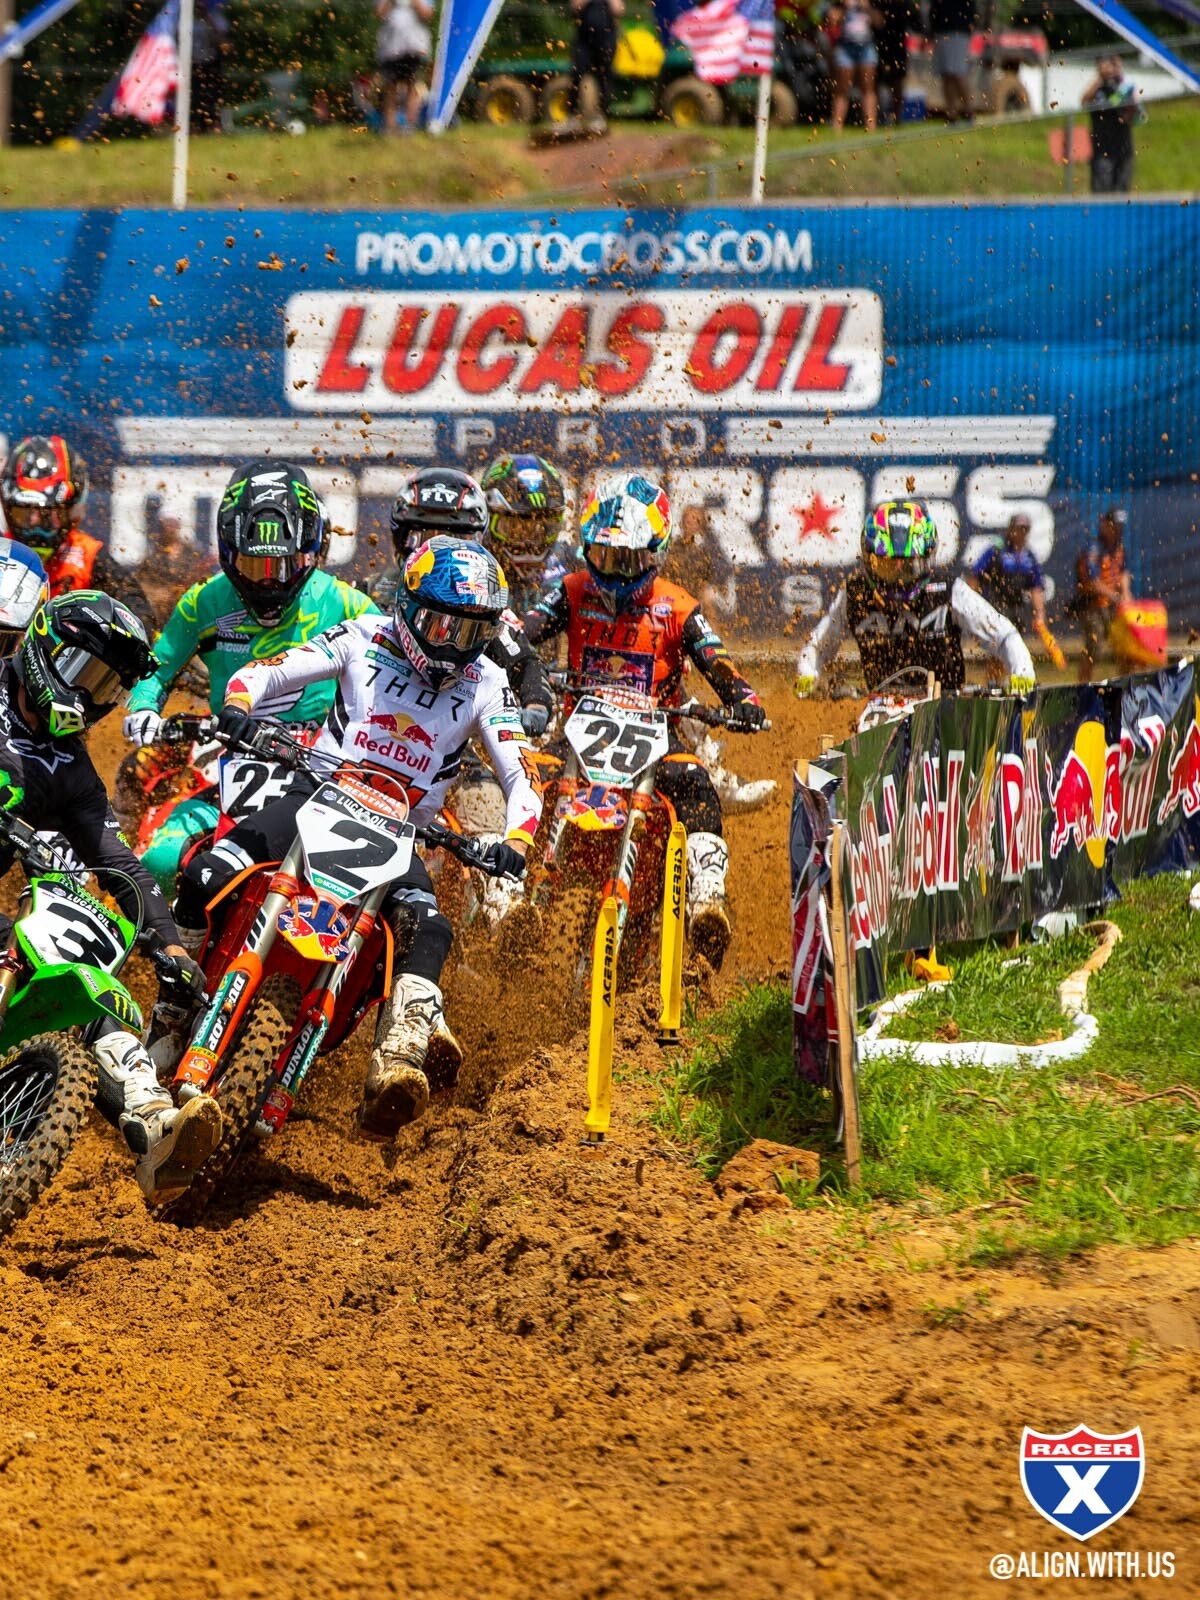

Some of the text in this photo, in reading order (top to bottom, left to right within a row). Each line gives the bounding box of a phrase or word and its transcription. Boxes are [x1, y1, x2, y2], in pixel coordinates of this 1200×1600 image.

[315, 303, 852, 396] LUCAS OIL
[421, 487, 458, 503] FLY
[248, 543, 288, 552] MONSTER
[457, 552, 479, 560] BELL
[26, 642, 45, 688] MONSTER
[354, 731, 432, 773] Red Bull
[579, 719, 658, 775] 25
[371, 815, 388, 830] OIL
[308, 819, 399, 891] 2
[322, 878, 350, 897] MOTOREX
[672, 847, 683, 920] ACERBIS
[66, 894, 99, 916] LUCAS
[97, 912, 110, 928] OIL
[46, 902, 118, 972] 3
[602, 925, 616, 1008] ACERBIS
[207, 973, 246, 1052] DULOP
[299, 1026, 328, 1079] MOTOREX
